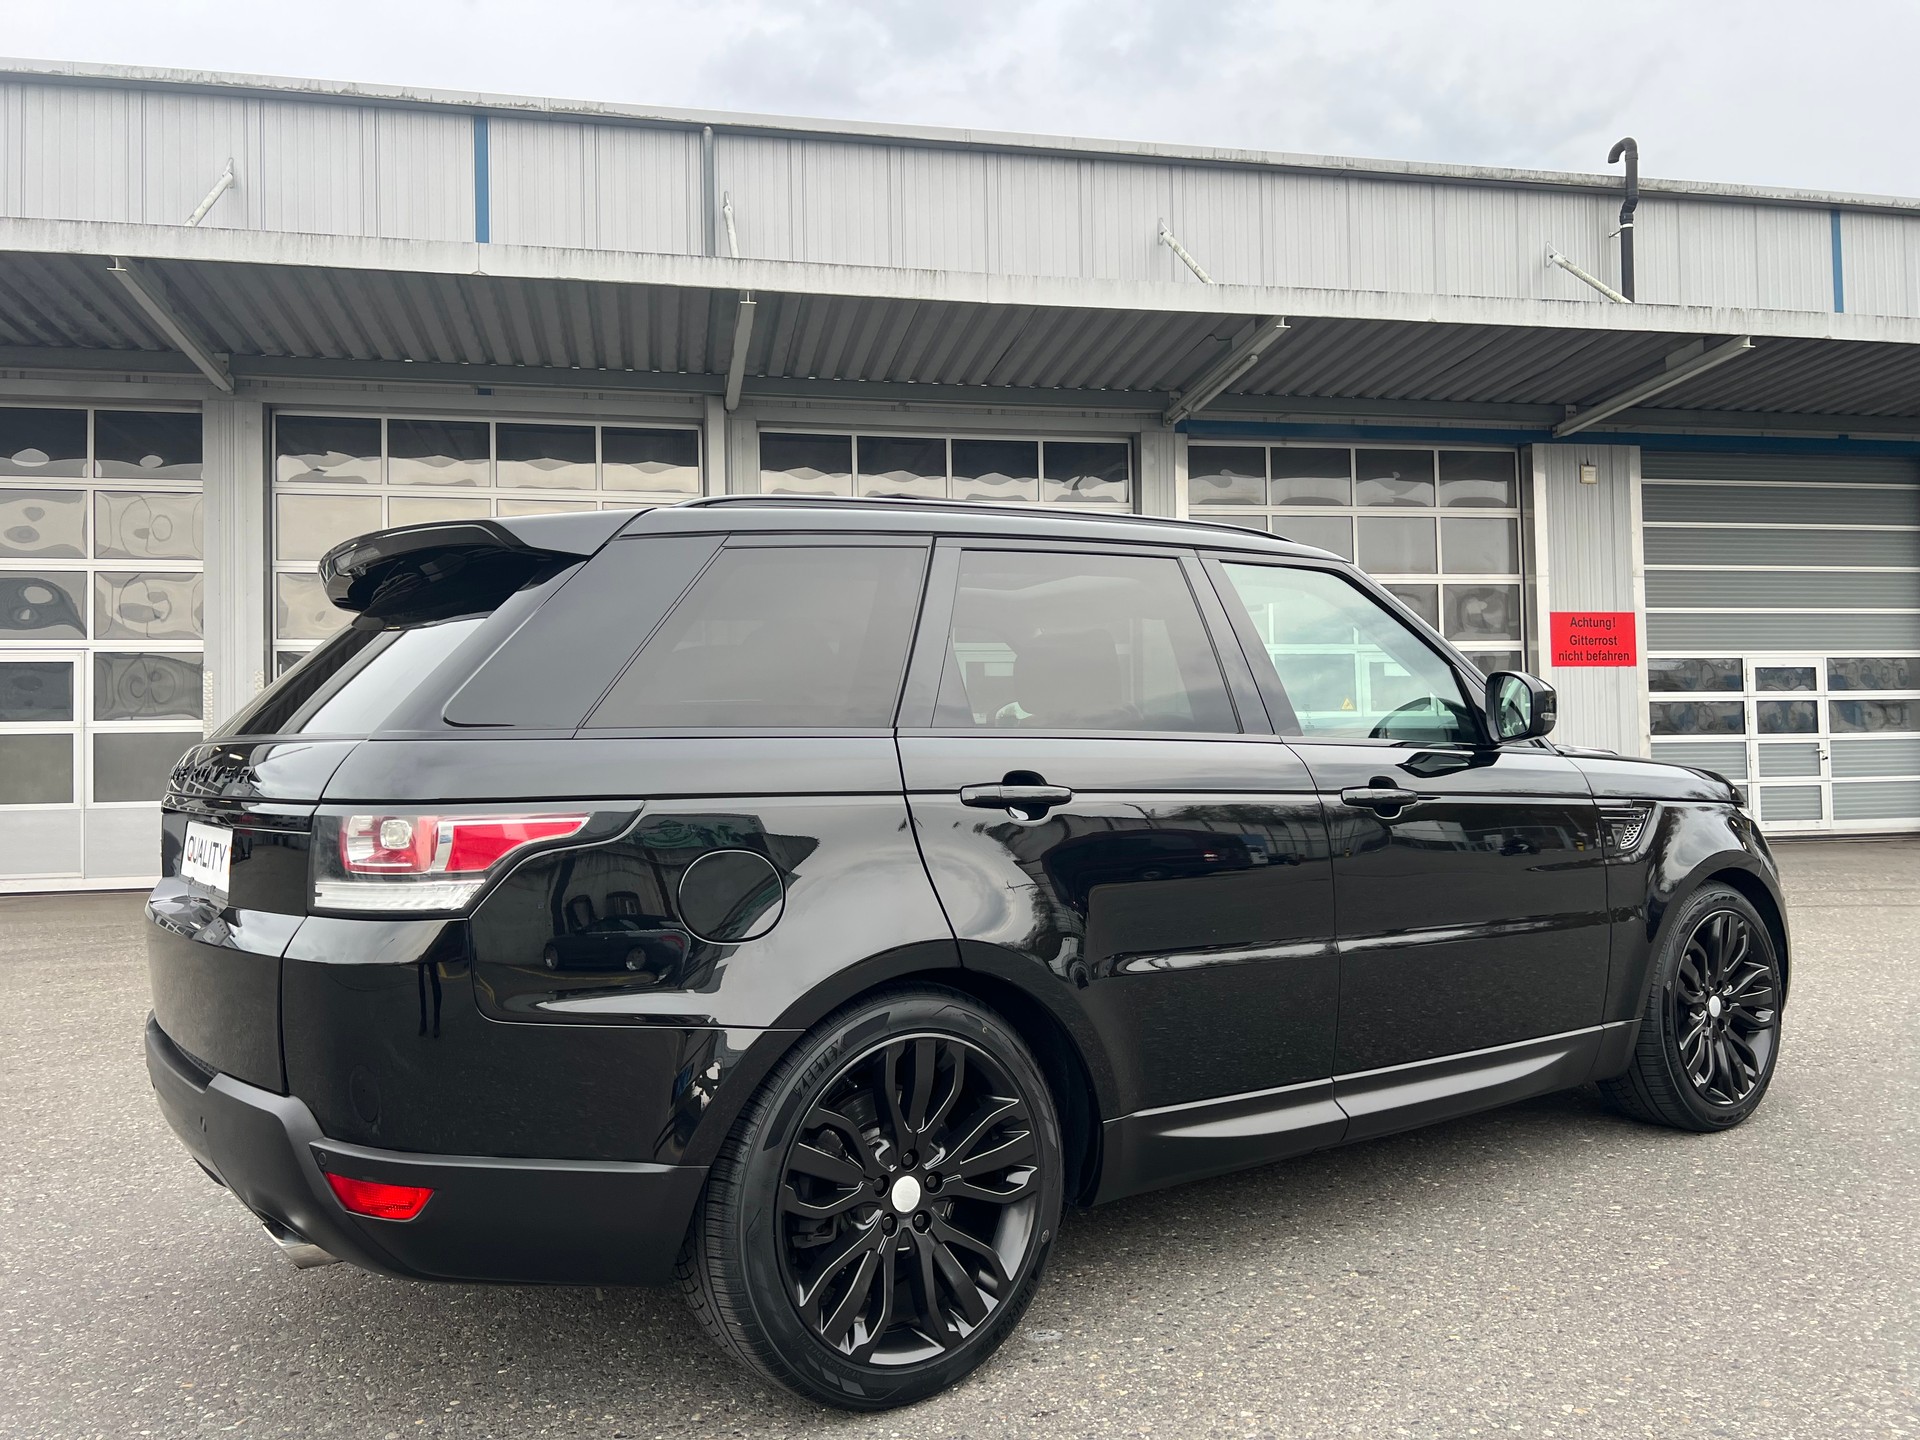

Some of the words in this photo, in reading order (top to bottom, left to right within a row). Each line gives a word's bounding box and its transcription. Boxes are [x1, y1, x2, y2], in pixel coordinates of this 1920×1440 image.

[1569, 617, 1616, 630] Achtung!
[1569, 635, 1618, 646] Gitterrost
[1558, 650, 1584, 661] nicht
[1586, 650, 1630, 661] befahren
[187, 836, 227, 872] QUALITY
[794, 1035, 847, 1097] ZEETEX
